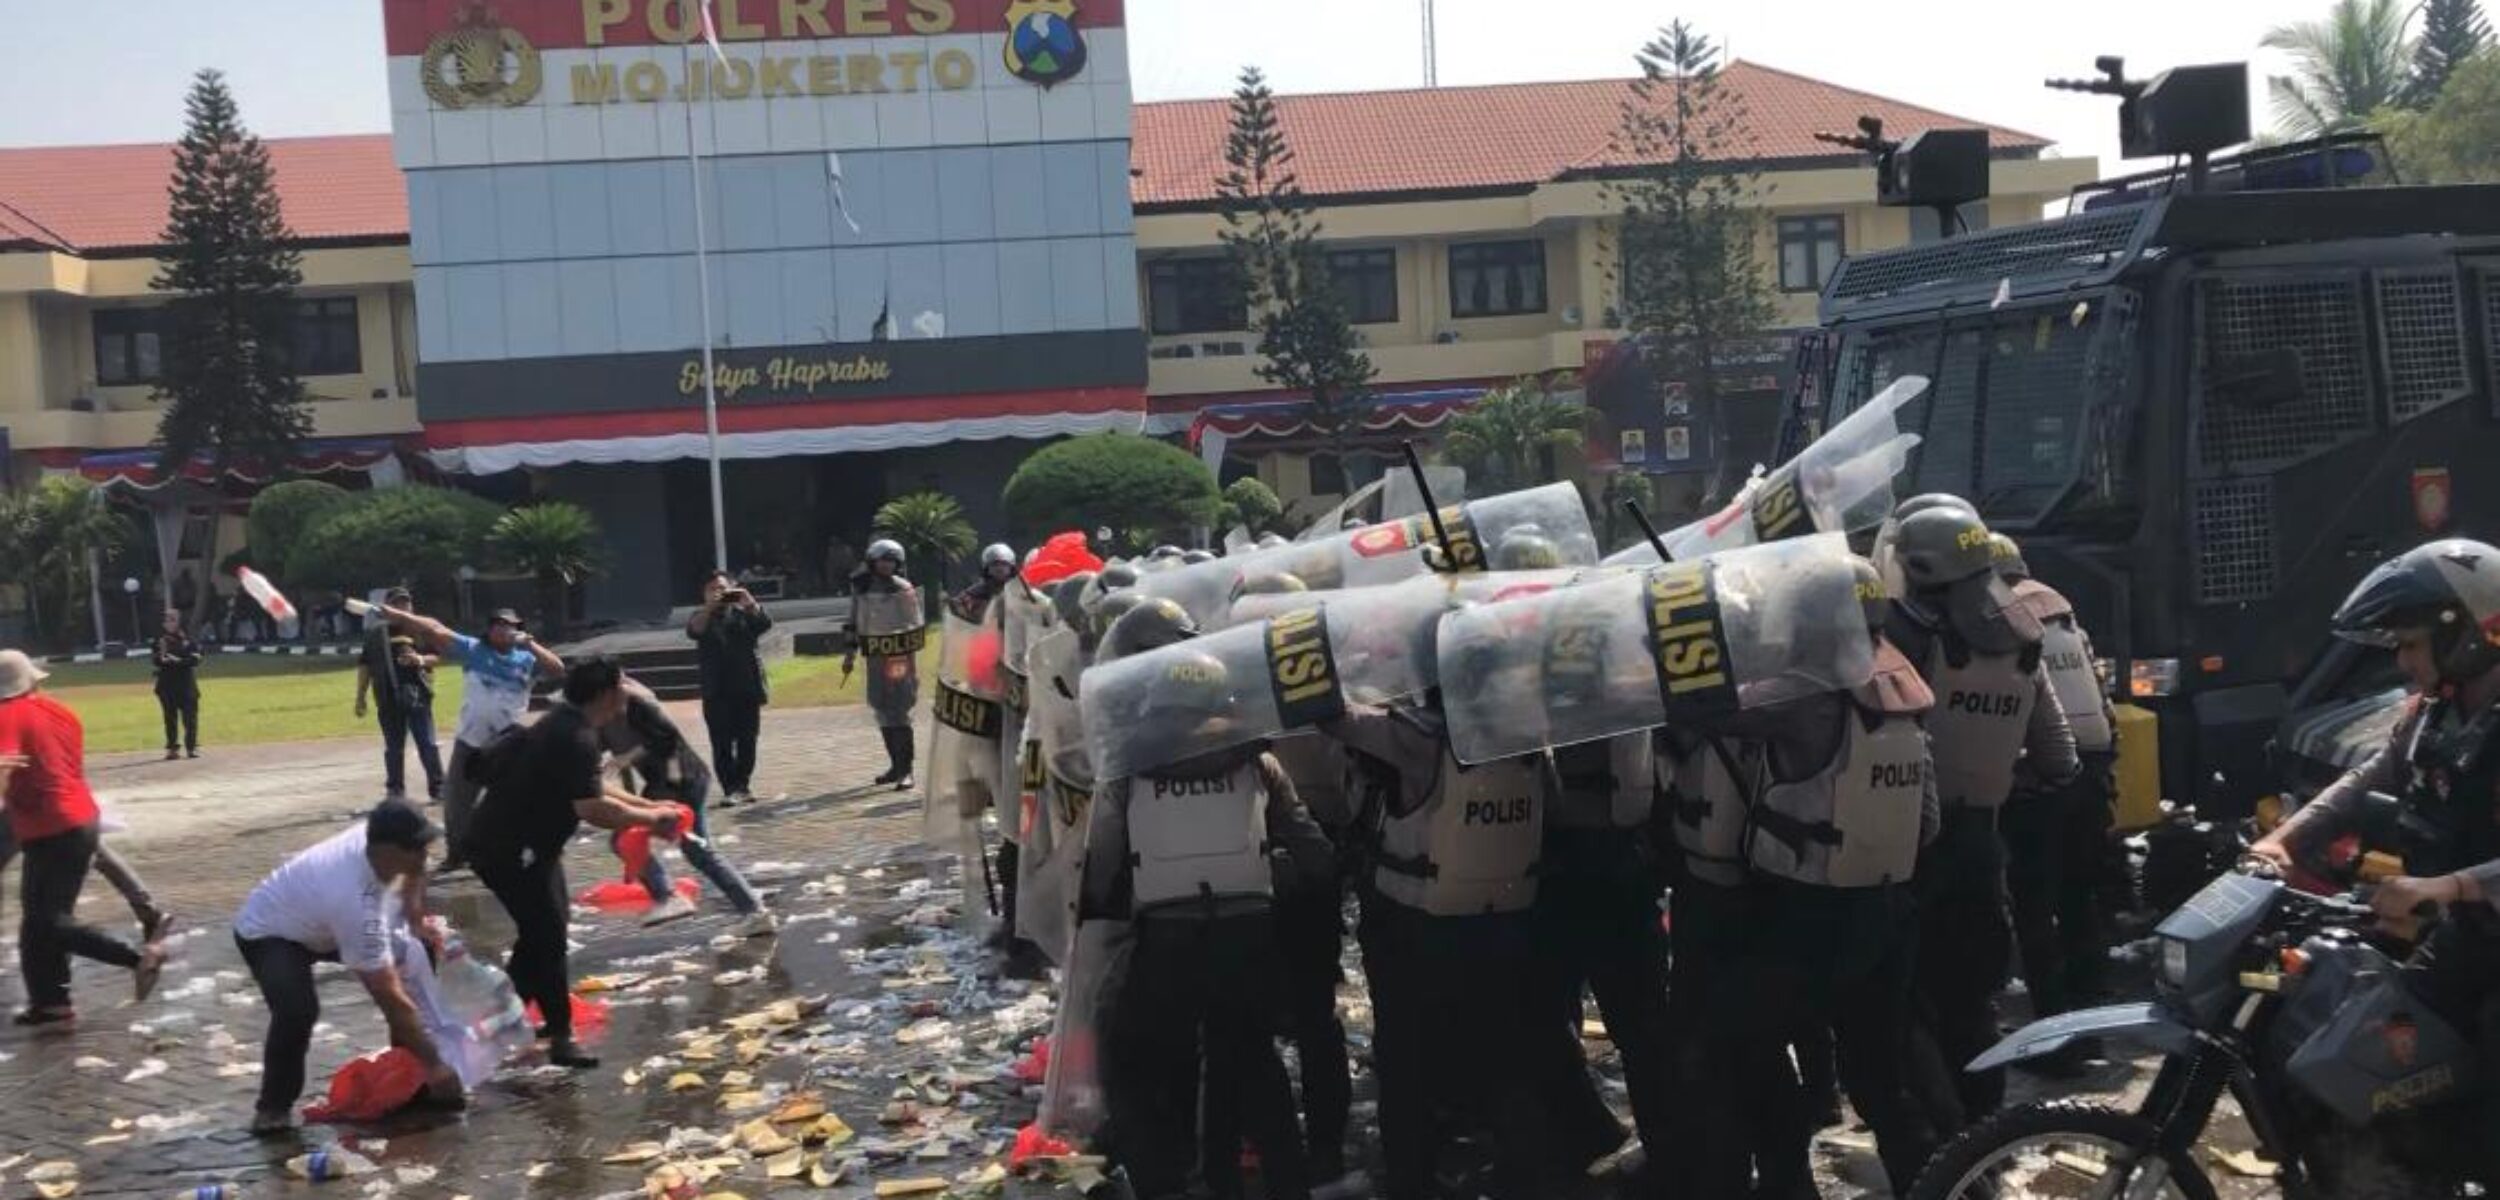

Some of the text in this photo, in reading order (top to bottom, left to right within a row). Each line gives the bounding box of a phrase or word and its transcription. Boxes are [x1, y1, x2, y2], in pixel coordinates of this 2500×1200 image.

[583, 0, 955, 44] POLRES
[570, 49, 974, 103] MOJOKERTO
[766, 355, 891, 393] Haprabu
[1950, 692, 2021, 717] POLISI
[1154, 775, 1234, 799] POLISI
[1871, 763, 1920, 788] POLIS
[1465, 796, 1531, 826] POLISI
